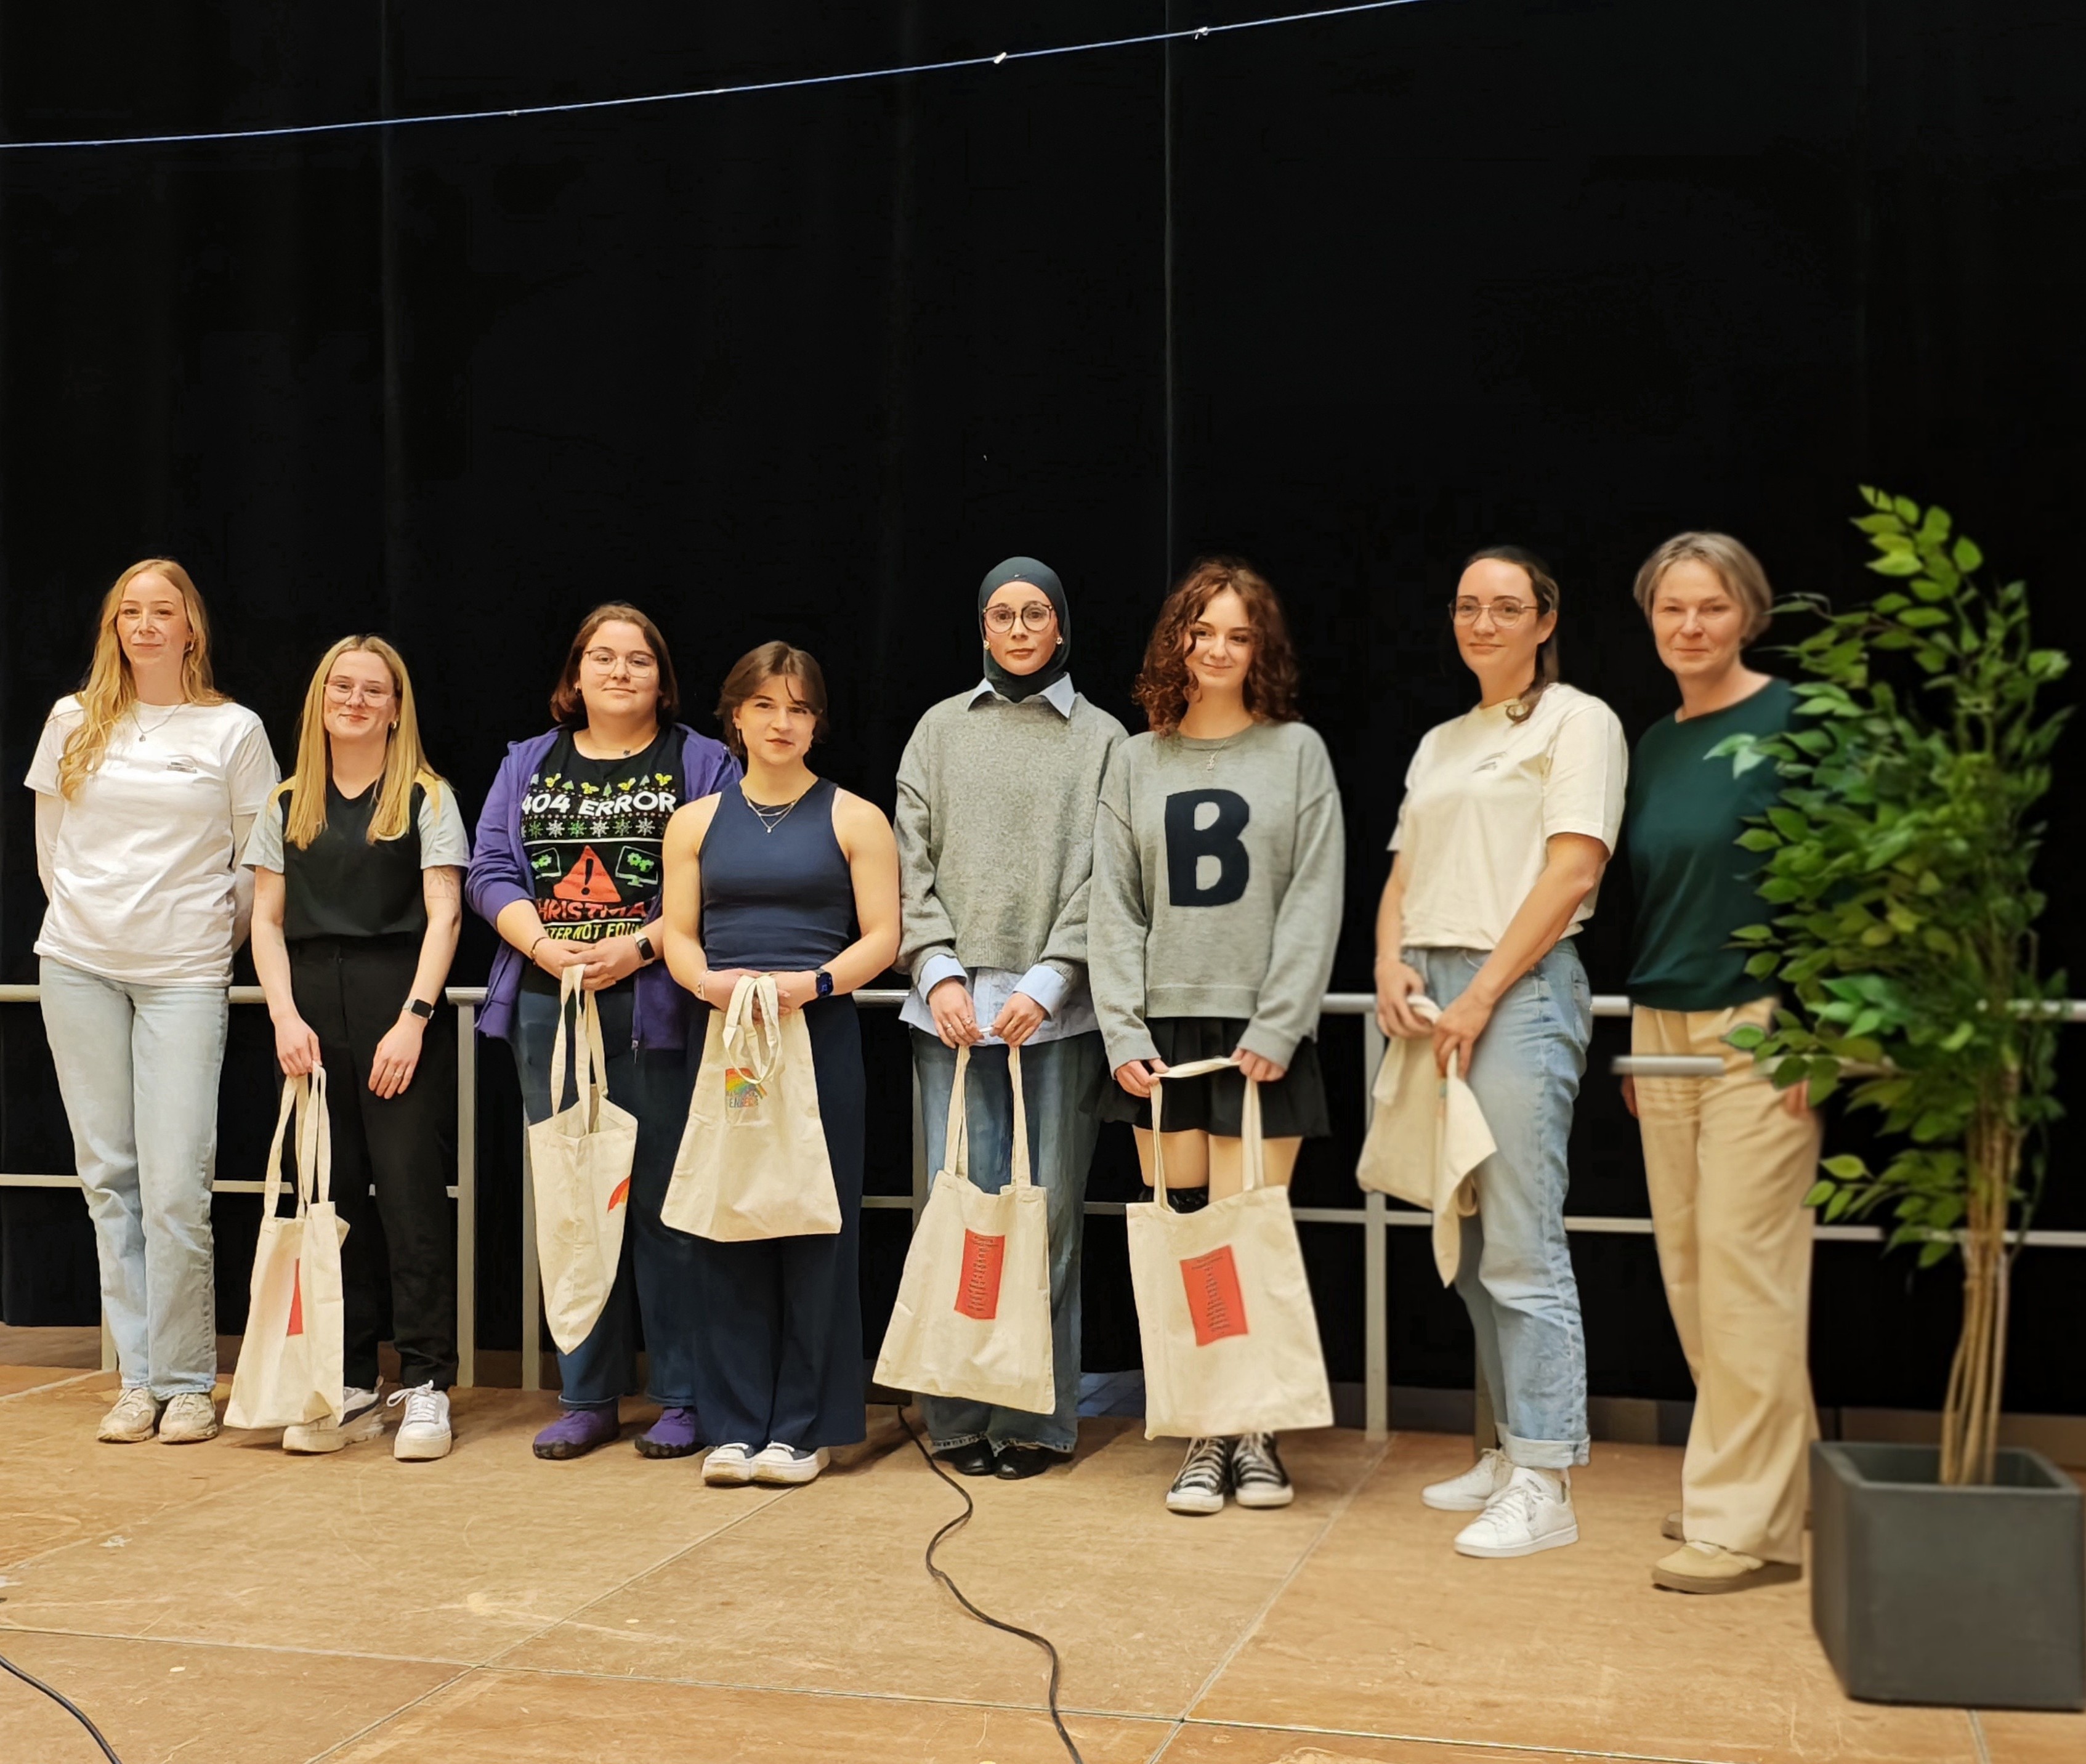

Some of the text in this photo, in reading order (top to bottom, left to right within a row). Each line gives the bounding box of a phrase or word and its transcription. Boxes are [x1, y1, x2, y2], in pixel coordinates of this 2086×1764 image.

[522, 791, 676, 817] 404 ERROR
[1165, 788, 1250, 907] B
[538, 898, 648, 921] HRISTMA
[573, 923, 602, 940] NOT
